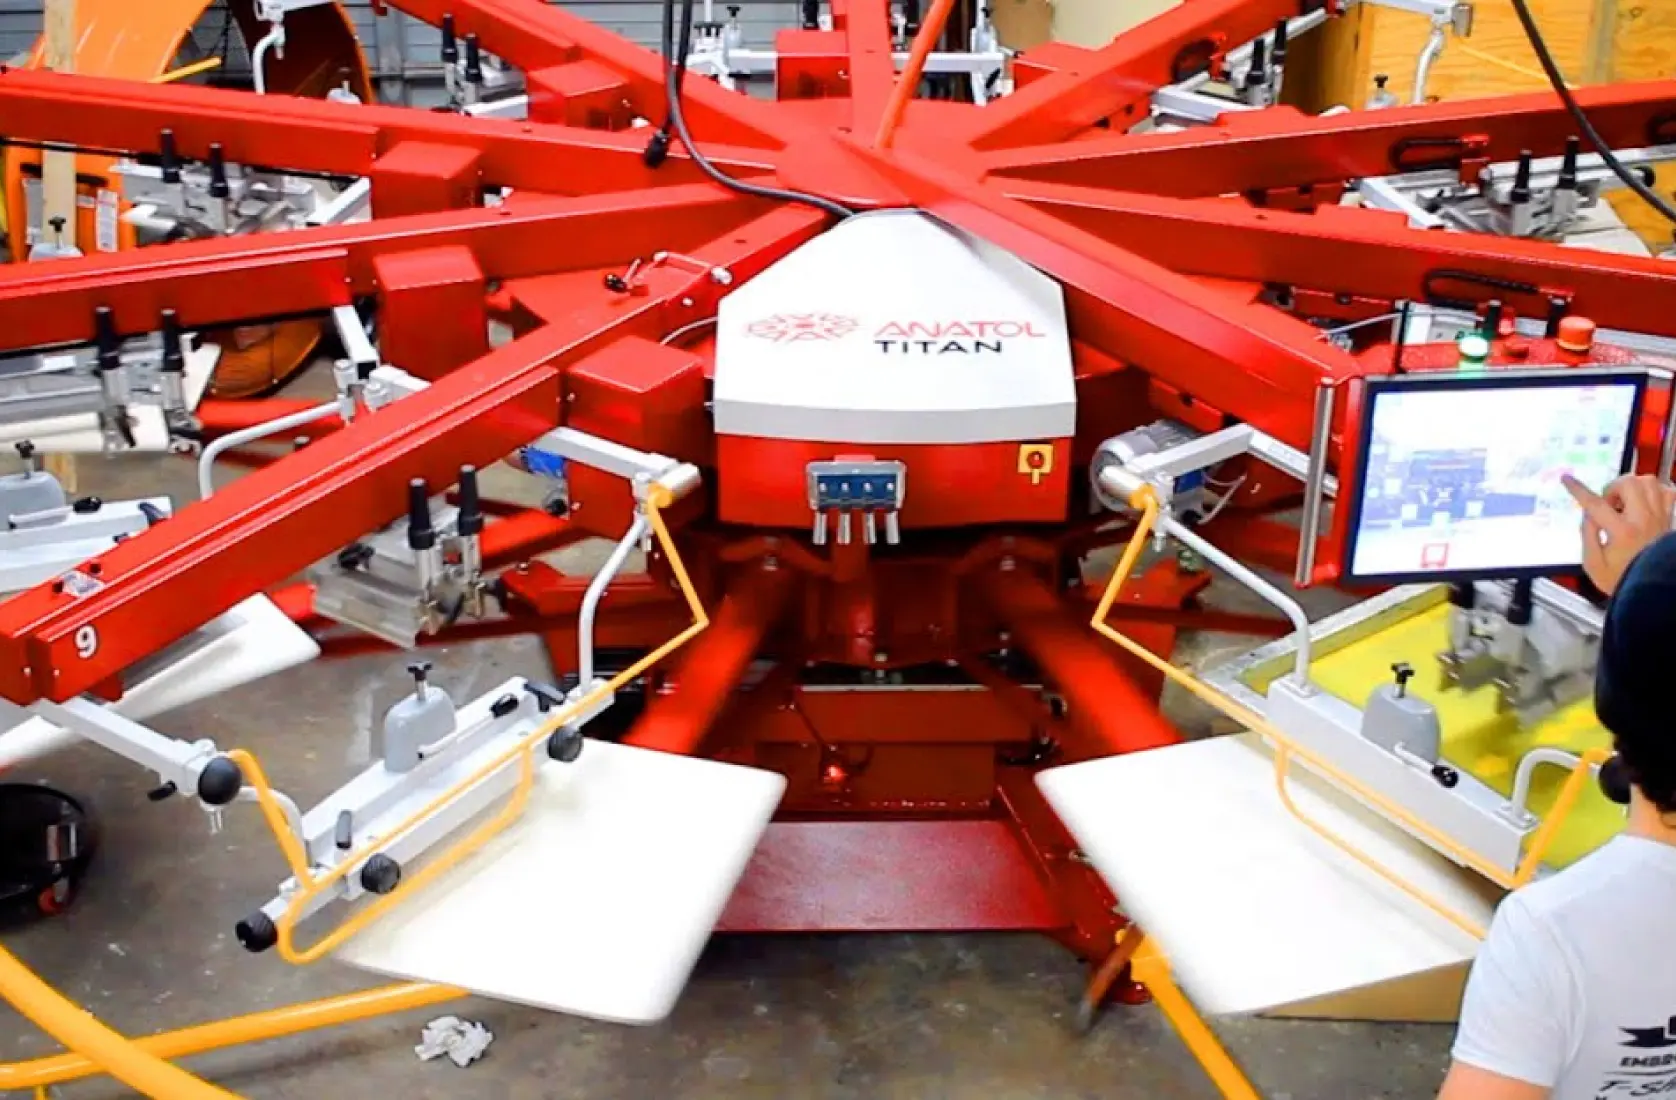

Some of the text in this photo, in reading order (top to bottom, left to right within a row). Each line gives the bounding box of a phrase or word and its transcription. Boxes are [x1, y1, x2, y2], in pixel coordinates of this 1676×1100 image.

[875, 321, 1046, 338] ANATOL
[874, 340, 1002, 353] TITAN
[75, 625, 97, 659] 9
